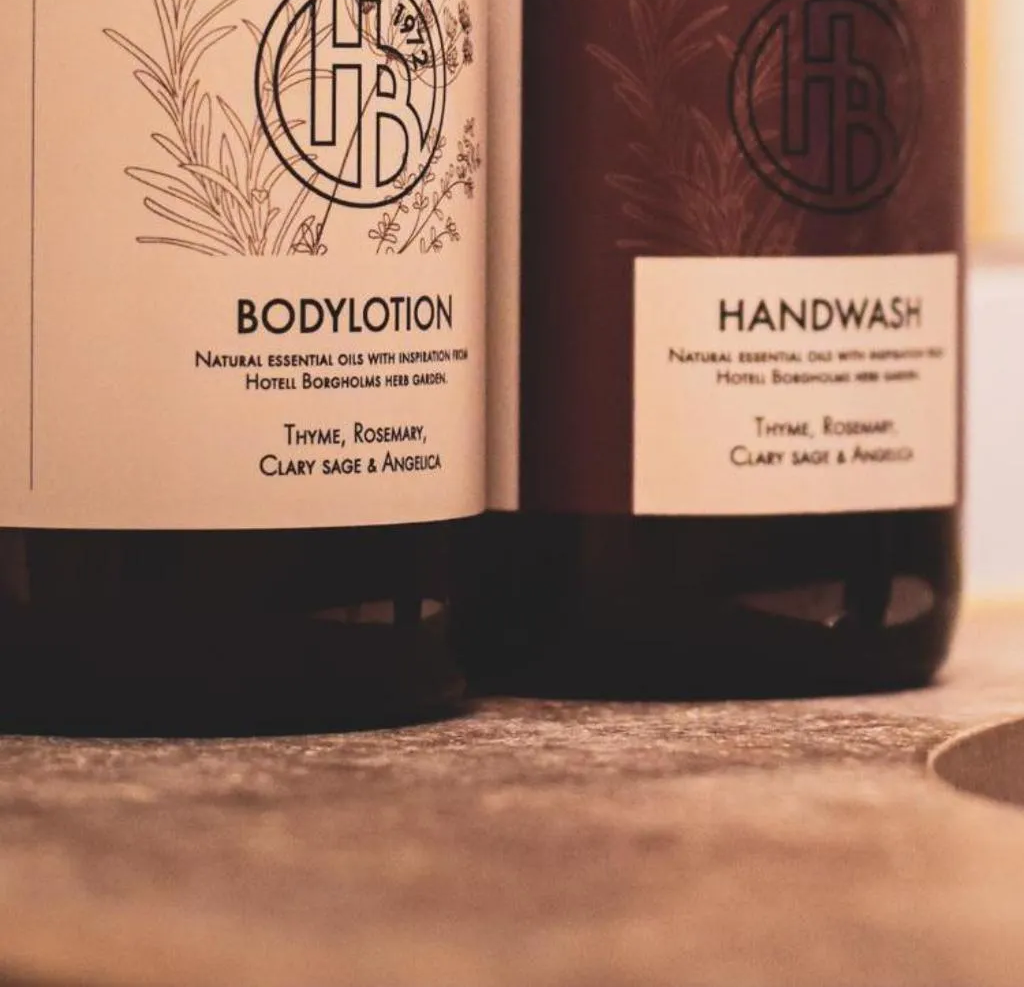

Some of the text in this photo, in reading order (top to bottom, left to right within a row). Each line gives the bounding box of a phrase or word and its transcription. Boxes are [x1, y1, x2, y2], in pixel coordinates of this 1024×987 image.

[394, 3, 429, 71] 1972
[237, 295, 452, 334] BODYLOTION
[719, 296, 922, 332] HANDWASH
[195, 350, 262, 368] NATURAL
[268, 354, 333, 367] ESSENTIAL
[338, 353, 364, 366] OILS
[368, 352, 395, 365] WITH
[399, 350, 450, 363] INSPIRATION
[668, 347, 732, 363] NATURAL
[246, 374, 296, 390] HOTELL
[302, 373, 381, 390] BORGHOLMS
[385, 376, 409, 387] HERB
[284, 422, 427, 447] THYME, ROSEMARY,
[755, 417, 814, 439] THYME,
[259, 452, 441, 476] CLARY SAGE & ANGELICA
[730, 445, 783, 466] CLARY
